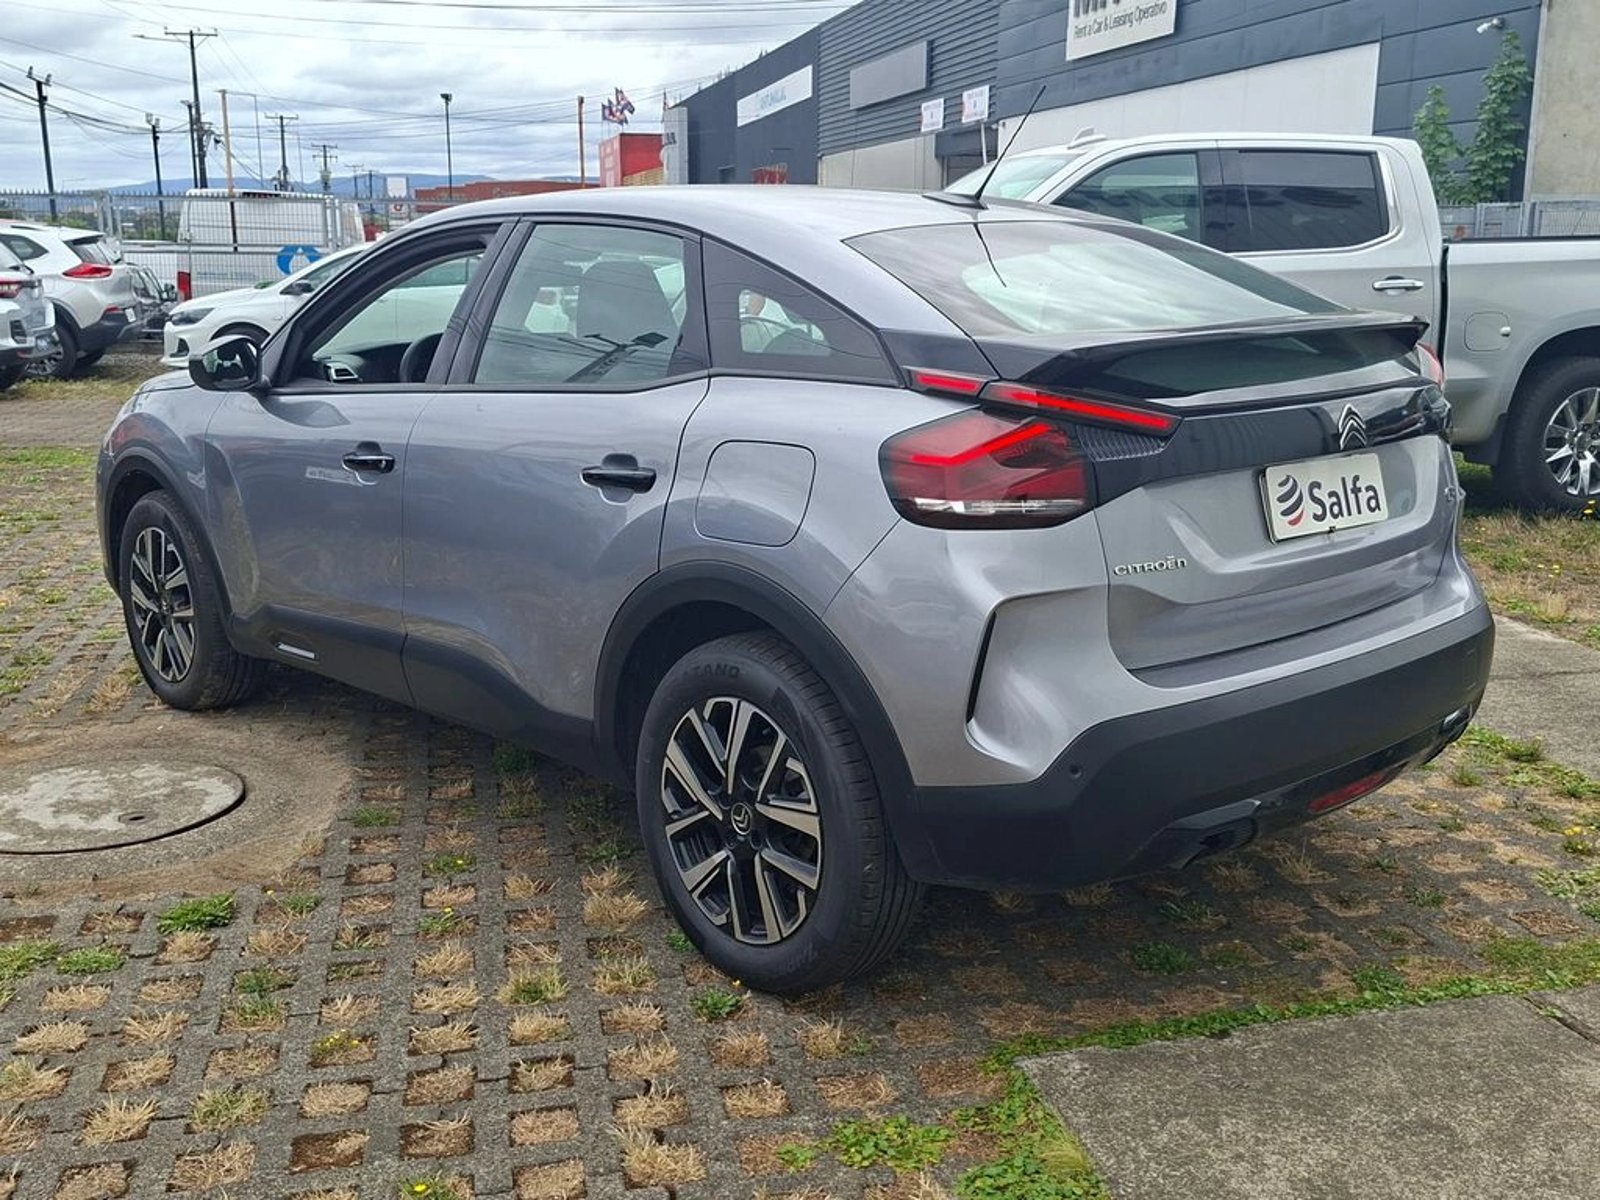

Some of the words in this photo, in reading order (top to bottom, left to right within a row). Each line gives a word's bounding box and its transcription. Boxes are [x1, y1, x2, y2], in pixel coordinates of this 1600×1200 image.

[1092, 18, 1103, 34] Car
[1109, 11, 1134, 30] Leasing
[1135, 1, 1168, 25] Operativo
[1308, 475, 1381, 522] Salfa
